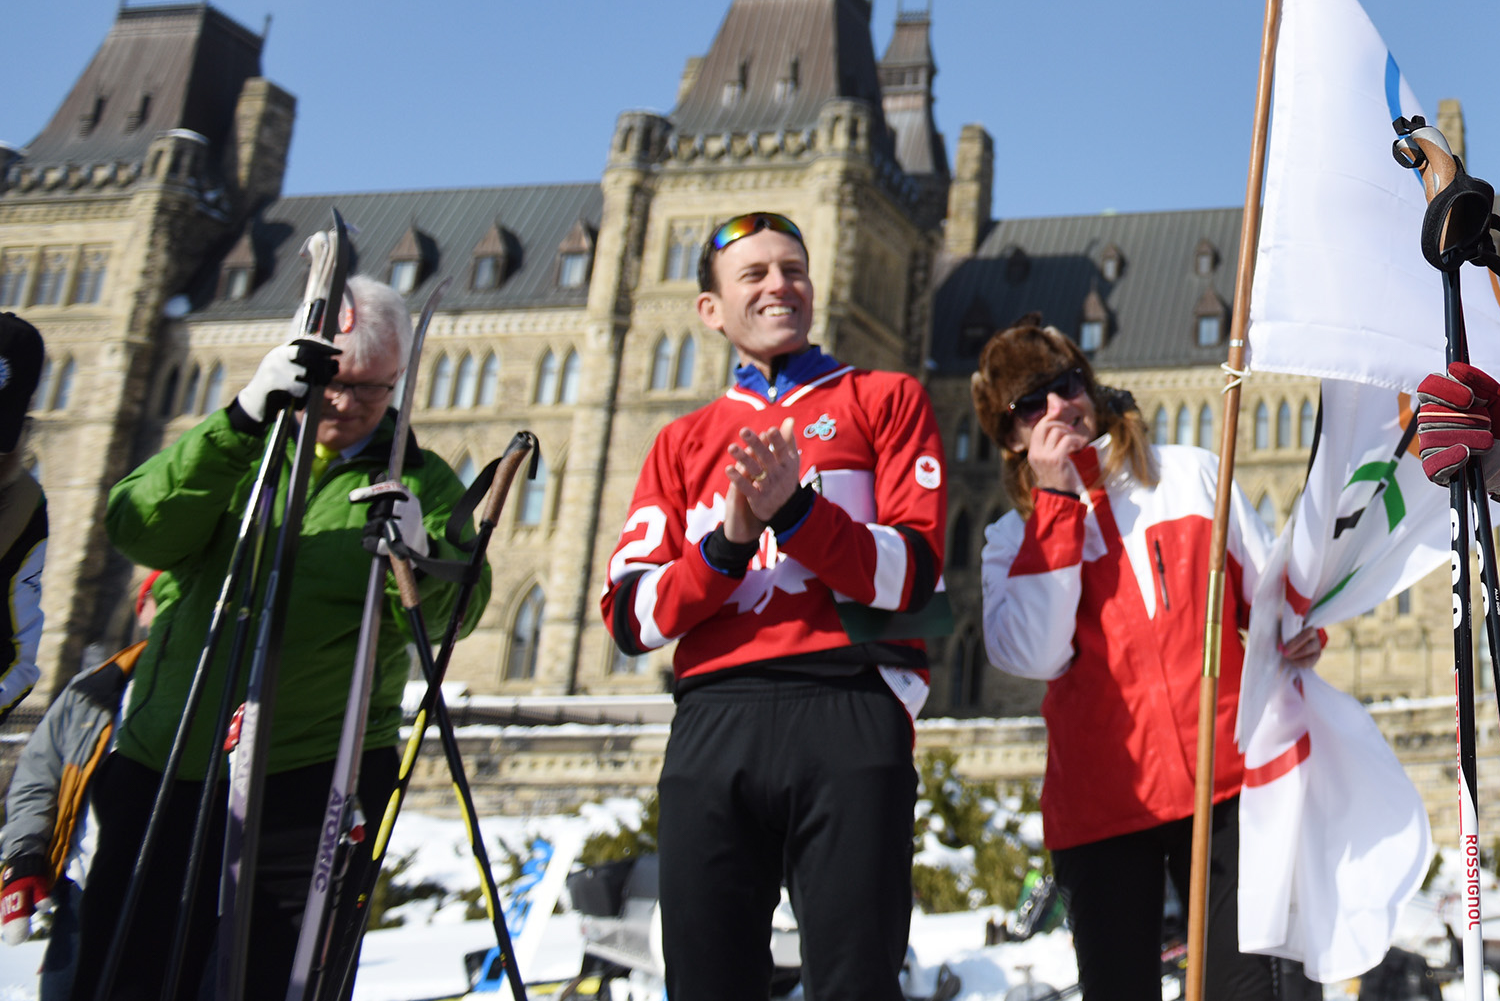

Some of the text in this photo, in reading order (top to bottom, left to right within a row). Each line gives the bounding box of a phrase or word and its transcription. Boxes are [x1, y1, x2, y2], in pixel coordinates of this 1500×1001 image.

[609, 505, 667, 585] 2
[314, 786, 343, 894] ATOMIC
[1465, 834, 1481, 931] ROSSIGNOL
